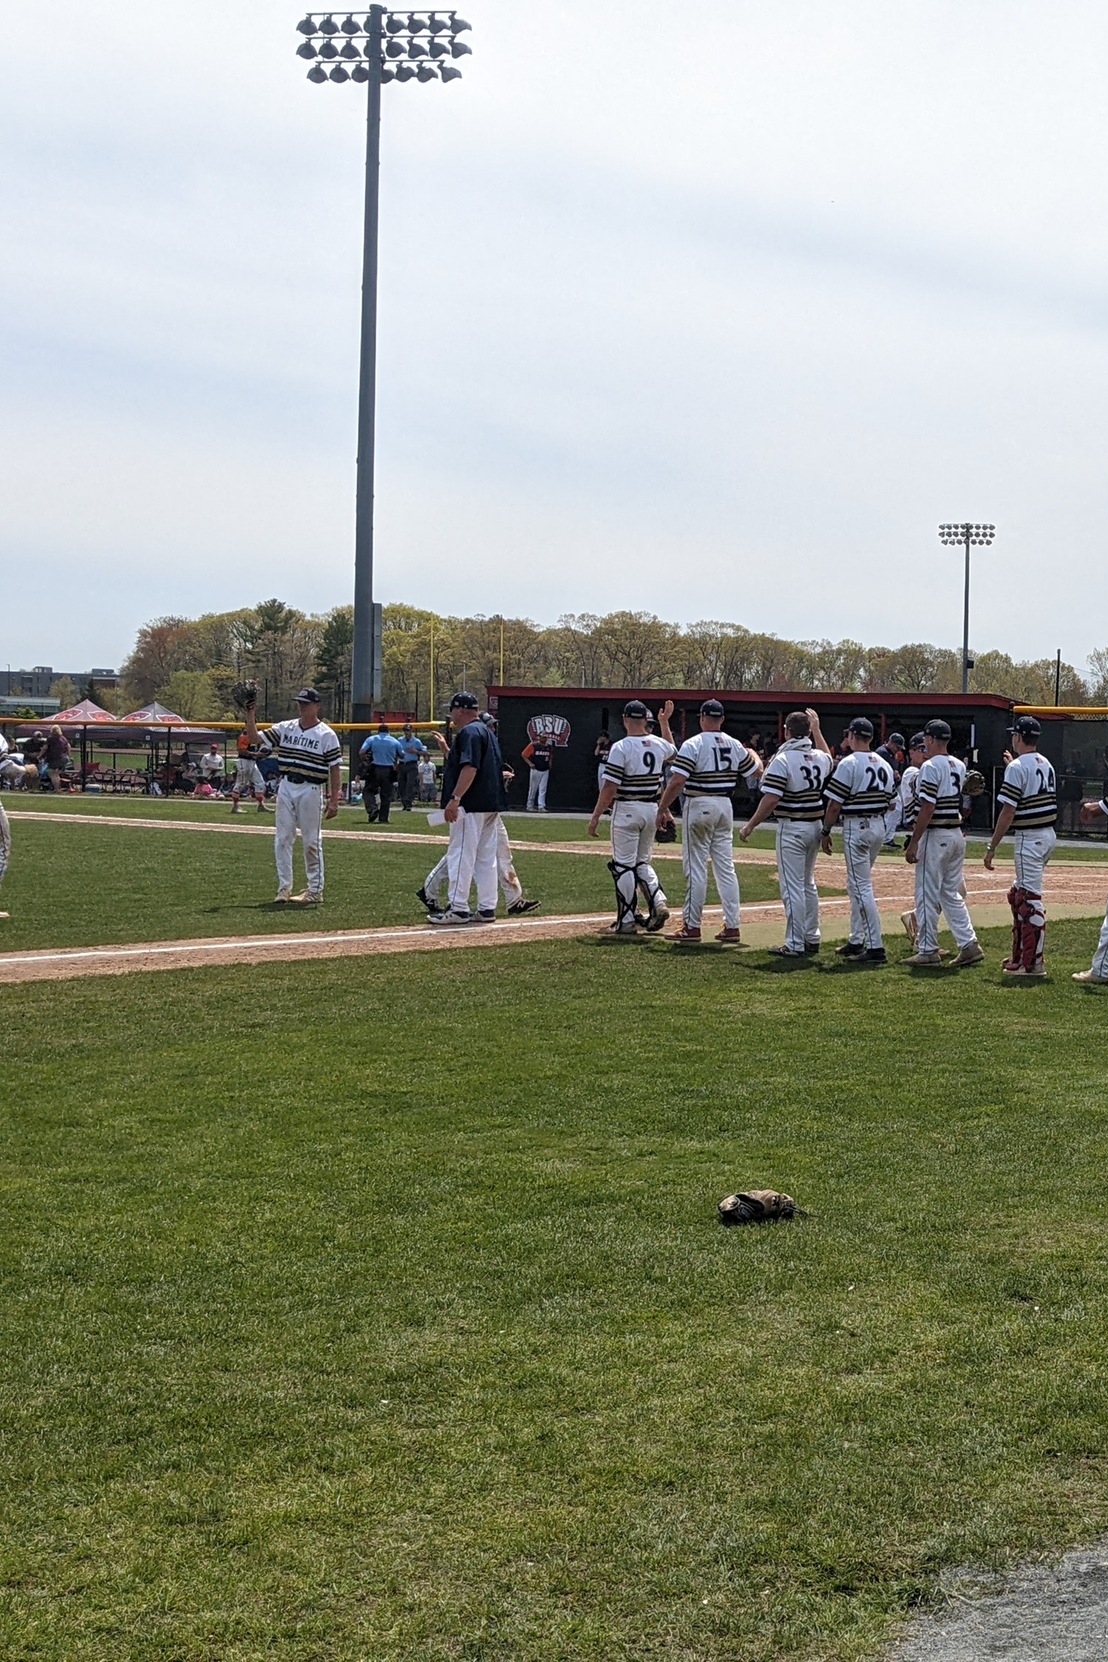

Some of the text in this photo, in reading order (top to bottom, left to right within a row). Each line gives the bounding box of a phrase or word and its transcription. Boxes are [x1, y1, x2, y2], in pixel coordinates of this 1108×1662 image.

[534, 716, 565, 735] BSU
[282, 734, 320, 750] MARITIME
[642, 751, 656, 775] 9
[711, 746, 732, 772] 15
[800, 764, 821, 791] 33
[865, 766, 888, 792] 29
[950, 771, 960, 796] 3
